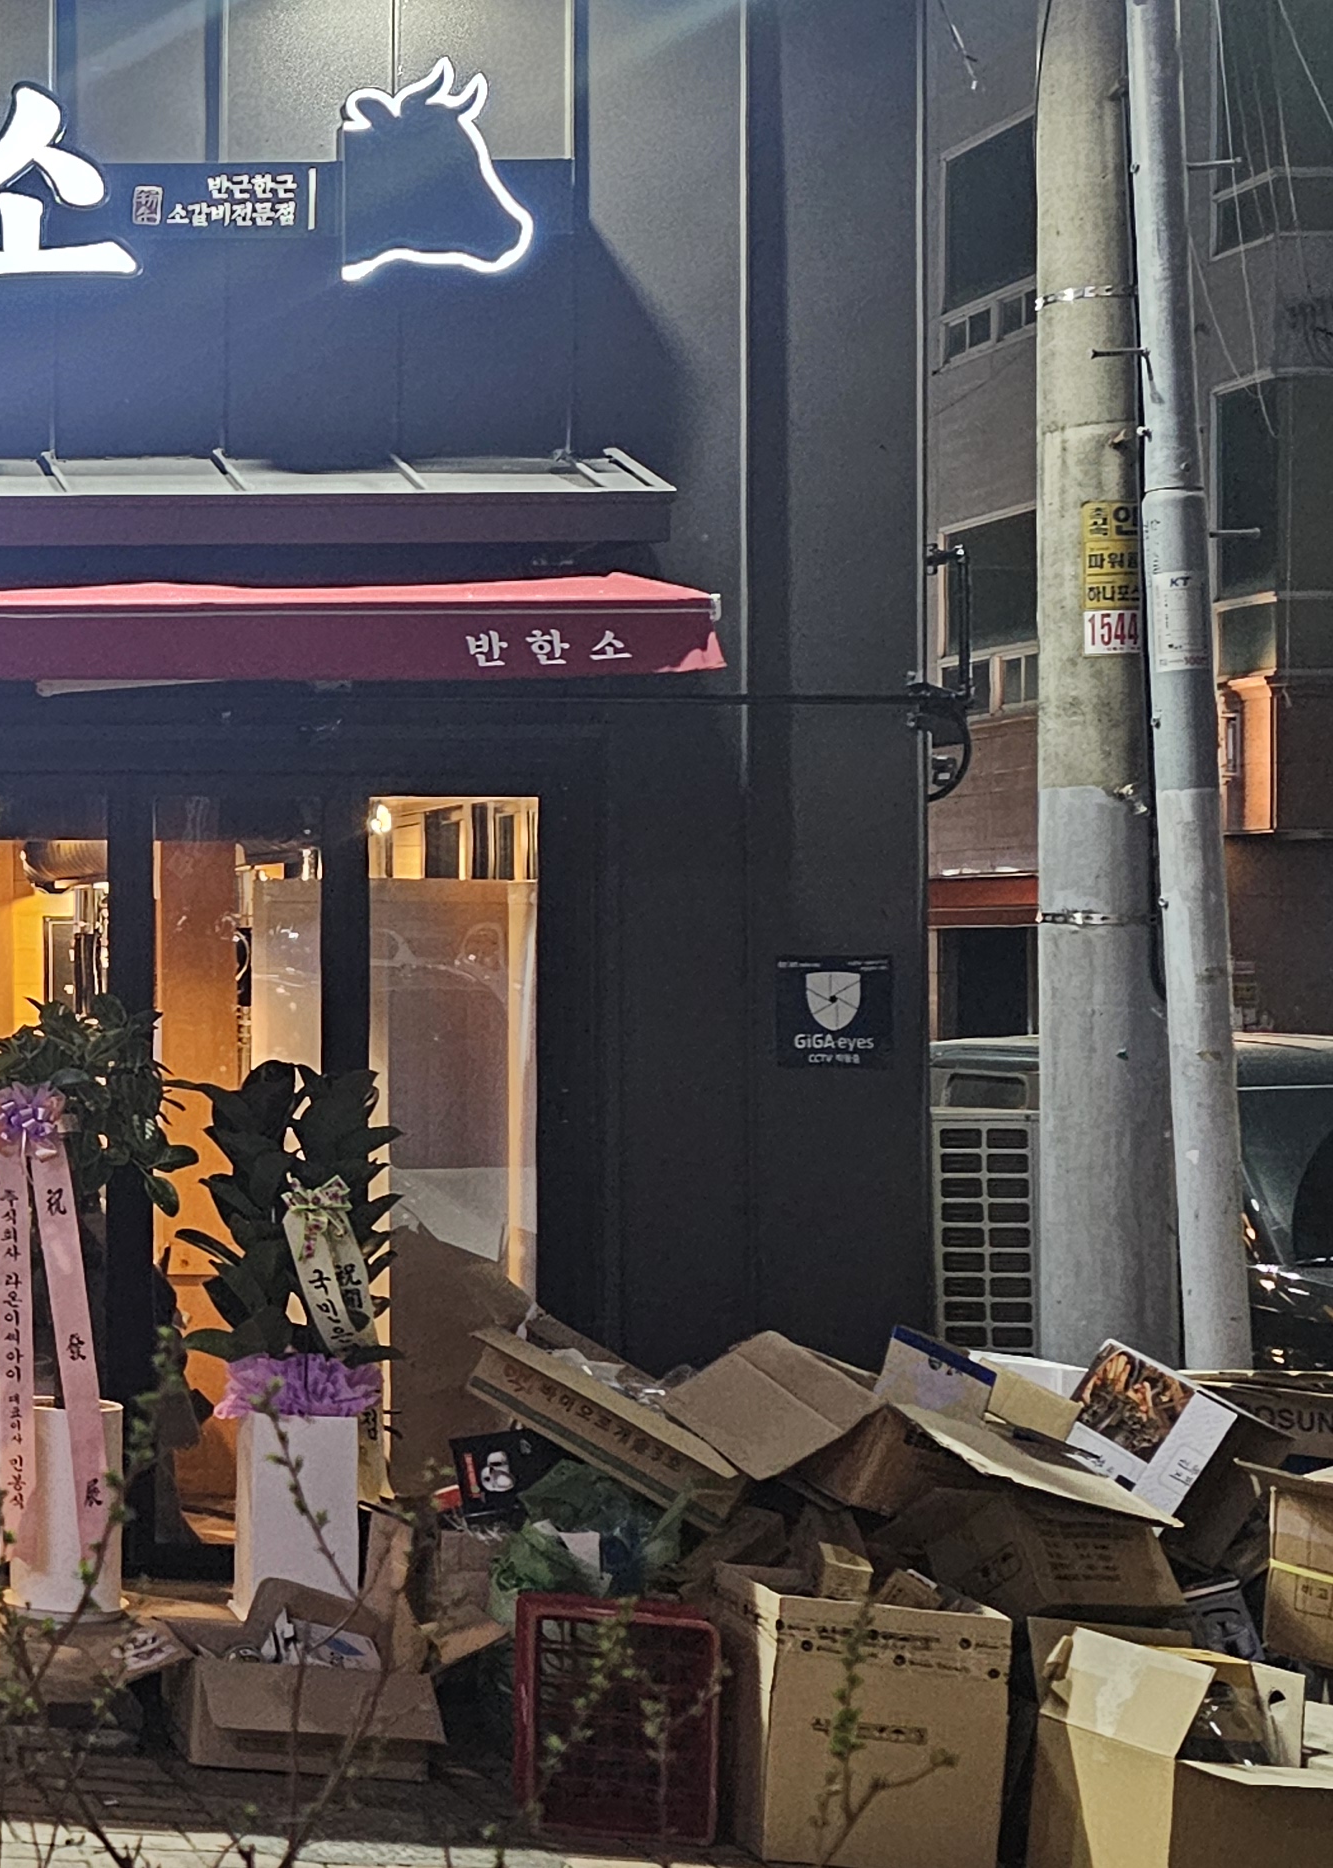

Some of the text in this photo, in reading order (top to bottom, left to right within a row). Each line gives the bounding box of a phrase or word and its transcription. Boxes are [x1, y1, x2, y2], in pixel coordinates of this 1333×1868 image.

[207, 173, 298, 199] 반근한근
[166, 201, 296, 227] 소갈비전문점
[1088, 612, 1139, 646] 1544
[0, 1189, 21, 1262] 주식회사
